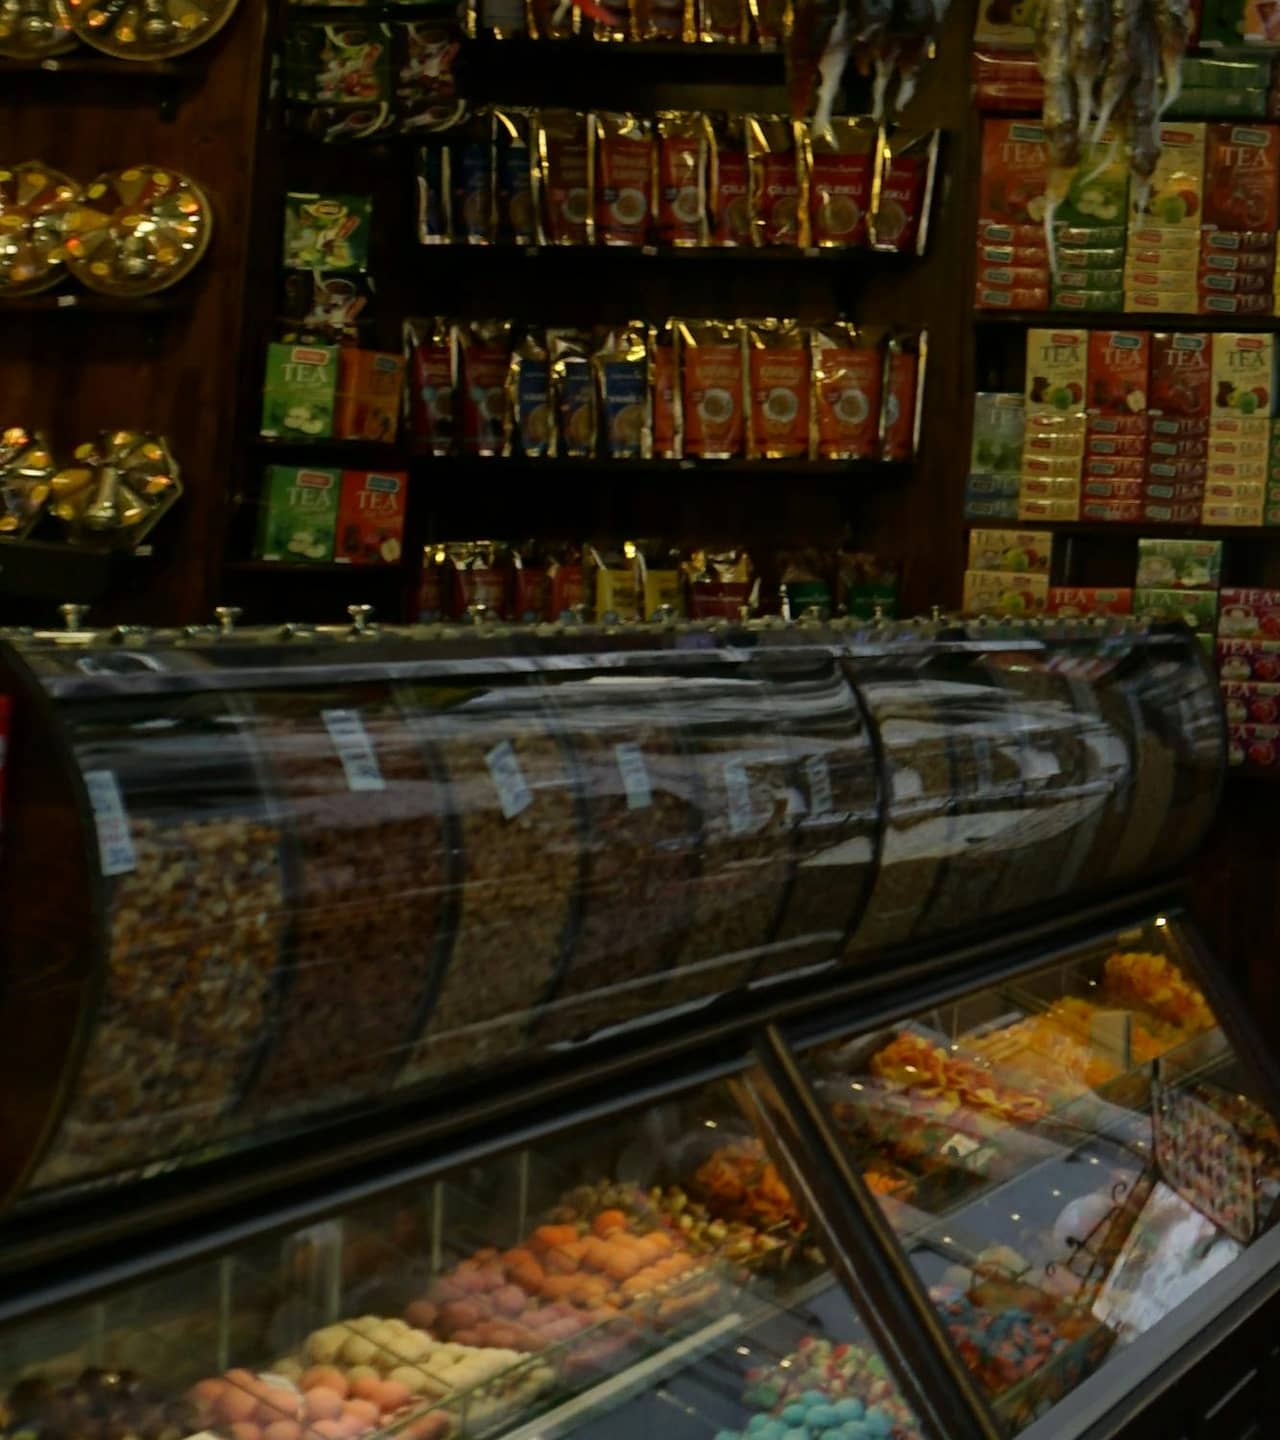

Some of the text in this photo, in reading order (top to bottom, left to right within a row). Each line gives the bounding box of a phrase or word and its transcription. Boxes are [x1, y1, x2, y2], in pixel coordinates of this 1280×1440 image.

[1001, 143, 1048, 164] TEA
[1218, 145, 1270, 167] TEA
[1040, 345, 1080, 363] TEA
[1101, 347, 1143, 366] TEA
[1164, 349, 1207, 367] TEA
[1226, 350, 1266, 368] TEA
[281, 363, 328, 386] TEA
[286, 486, 333, 509] TEA
[355, 488, 398, 511] TEA
[1054, 590, 1087, 604] TEA
[1238, 591, 1273, 606] TEA
[1220, 641, 1254, 655] TEA
